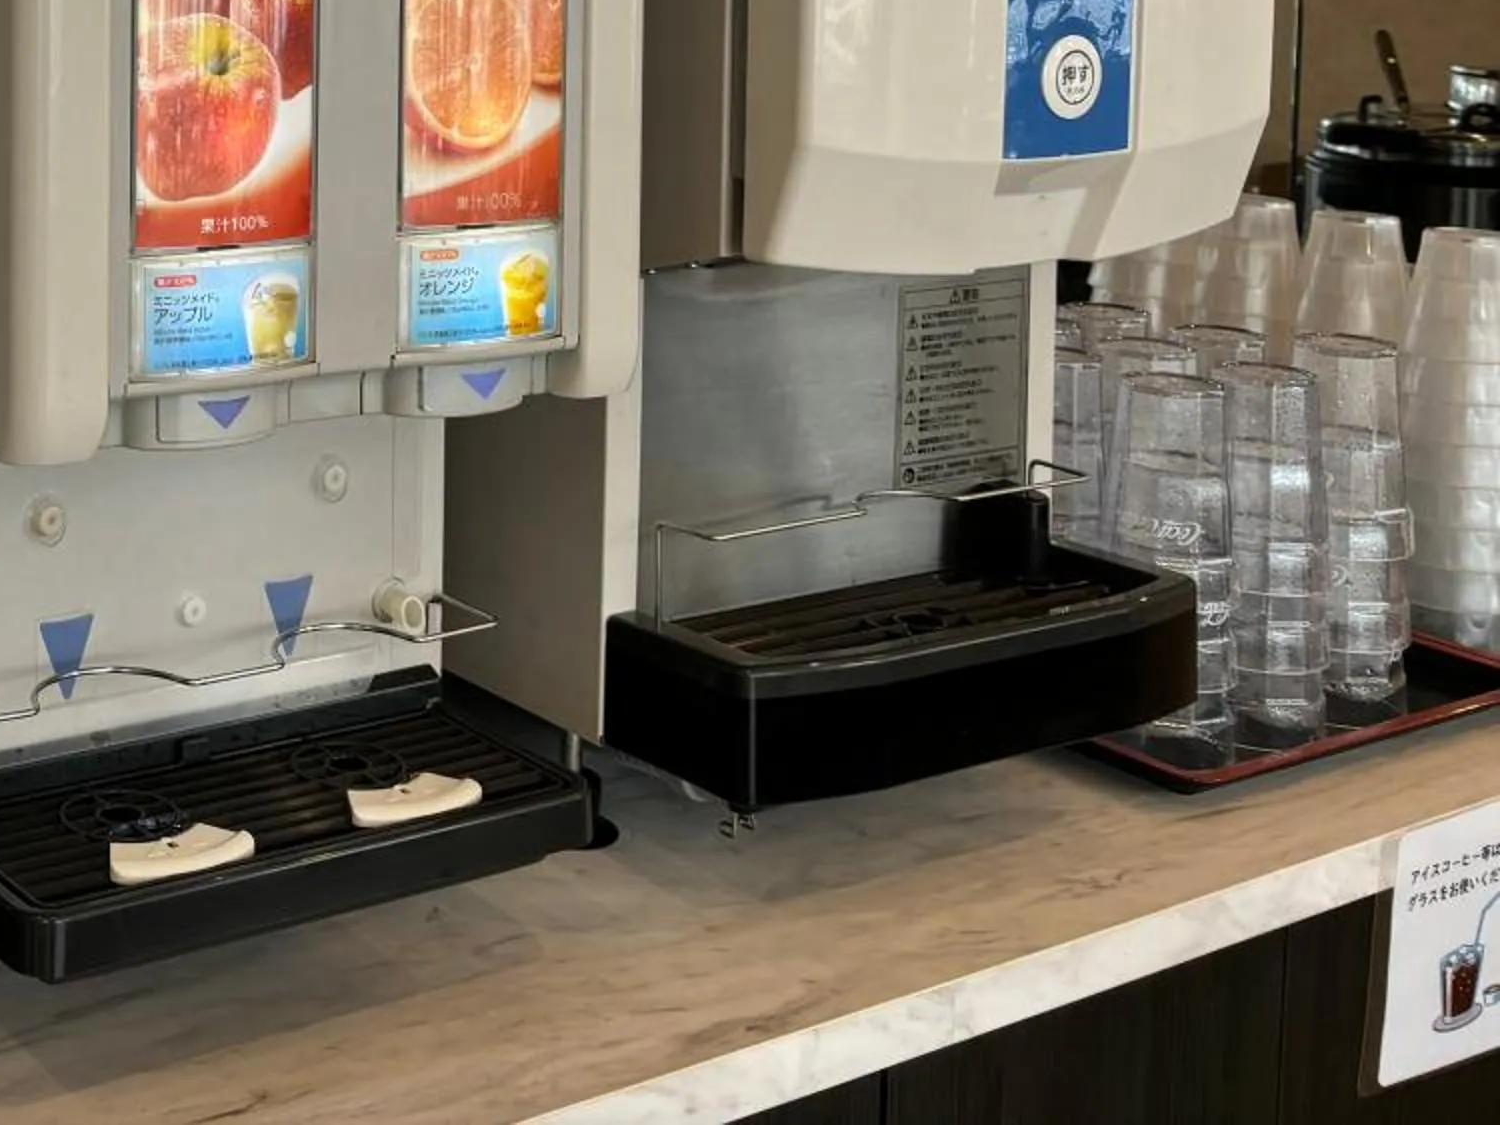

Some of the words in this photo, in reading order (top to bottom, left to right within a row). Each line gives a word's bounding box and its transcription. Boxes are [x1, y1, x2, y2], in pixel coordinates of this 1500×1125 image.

[1061, 65, 1090, 87] 押す
[201, 215, 269, 234] 果汁100%
[419, 278, 475, 297] オレンジ
[153, 307, 213, 325] アップル
